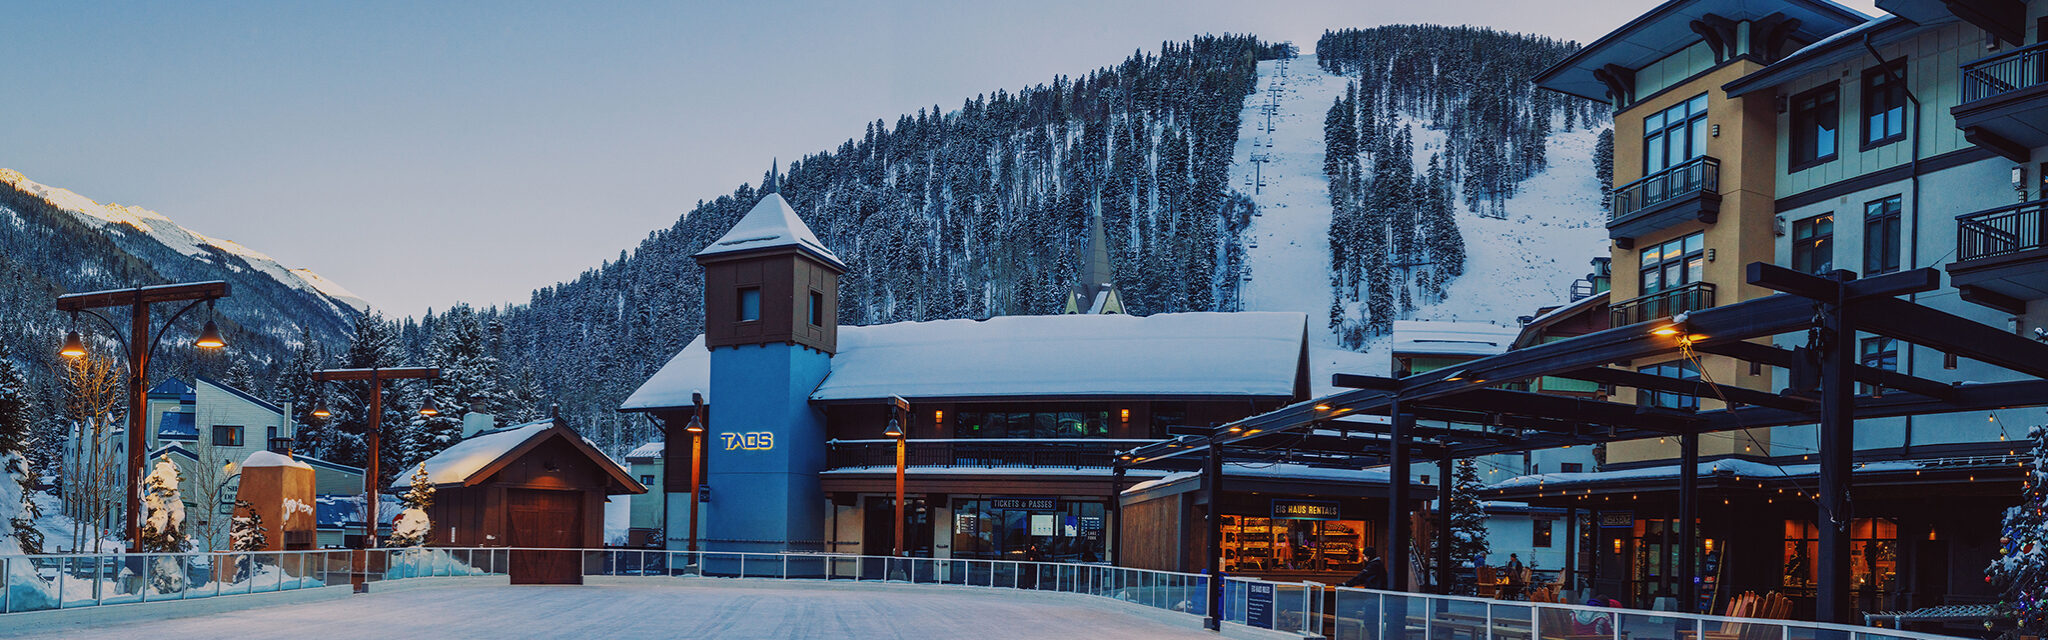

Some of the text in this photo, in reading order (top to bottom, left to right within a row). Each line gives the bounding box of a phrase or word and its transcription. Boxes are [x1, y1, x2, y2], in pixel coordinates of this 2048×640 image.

[720, 432, 774, 450] TAOS
[994, 499, 1053, 509] TICKETS & PASSES
[1275, 504, 1337, 515] EIS HAUS RENTALS
